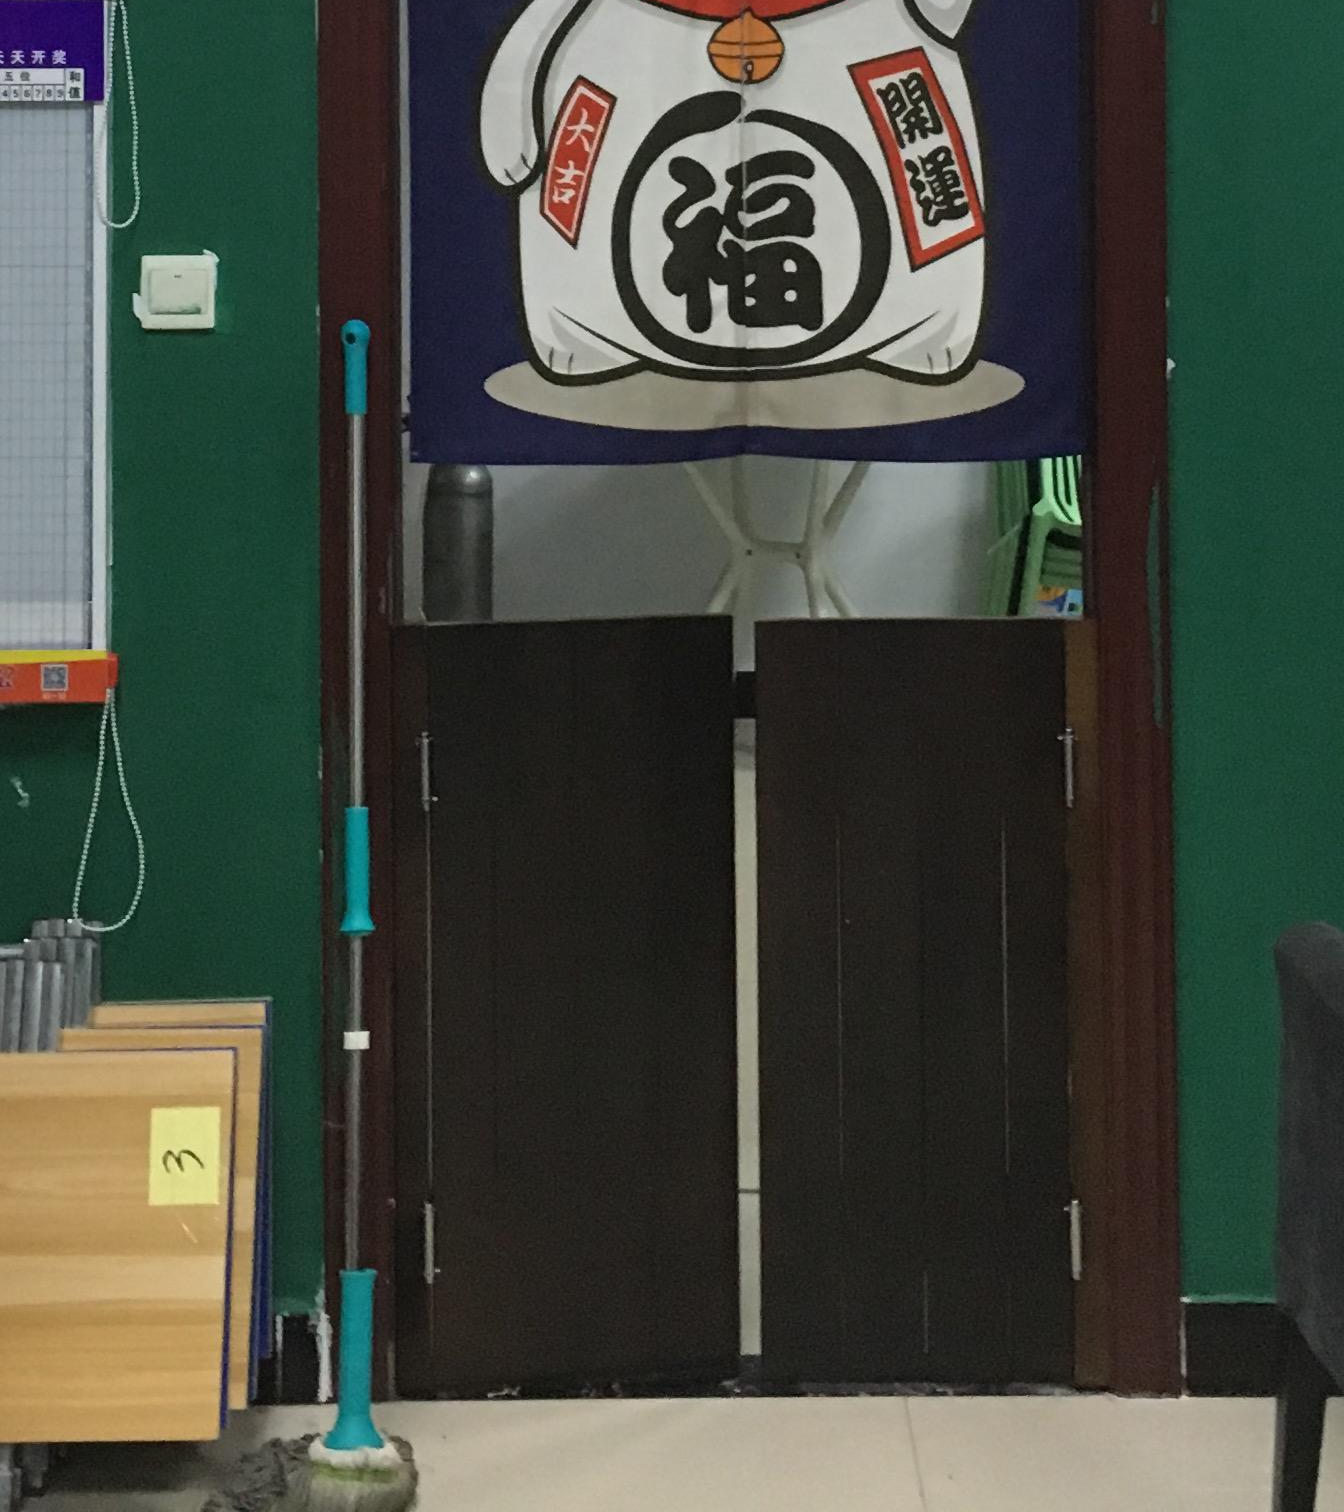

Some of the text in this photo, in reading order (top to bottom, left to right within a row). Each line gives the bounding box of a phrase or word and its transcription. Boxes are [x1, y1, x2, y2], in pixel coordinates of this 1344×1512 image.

[550, 107, 595, 206] 大吉
[874, 70, 971, 228] 開運
[661, 148, 825, 334] 福
